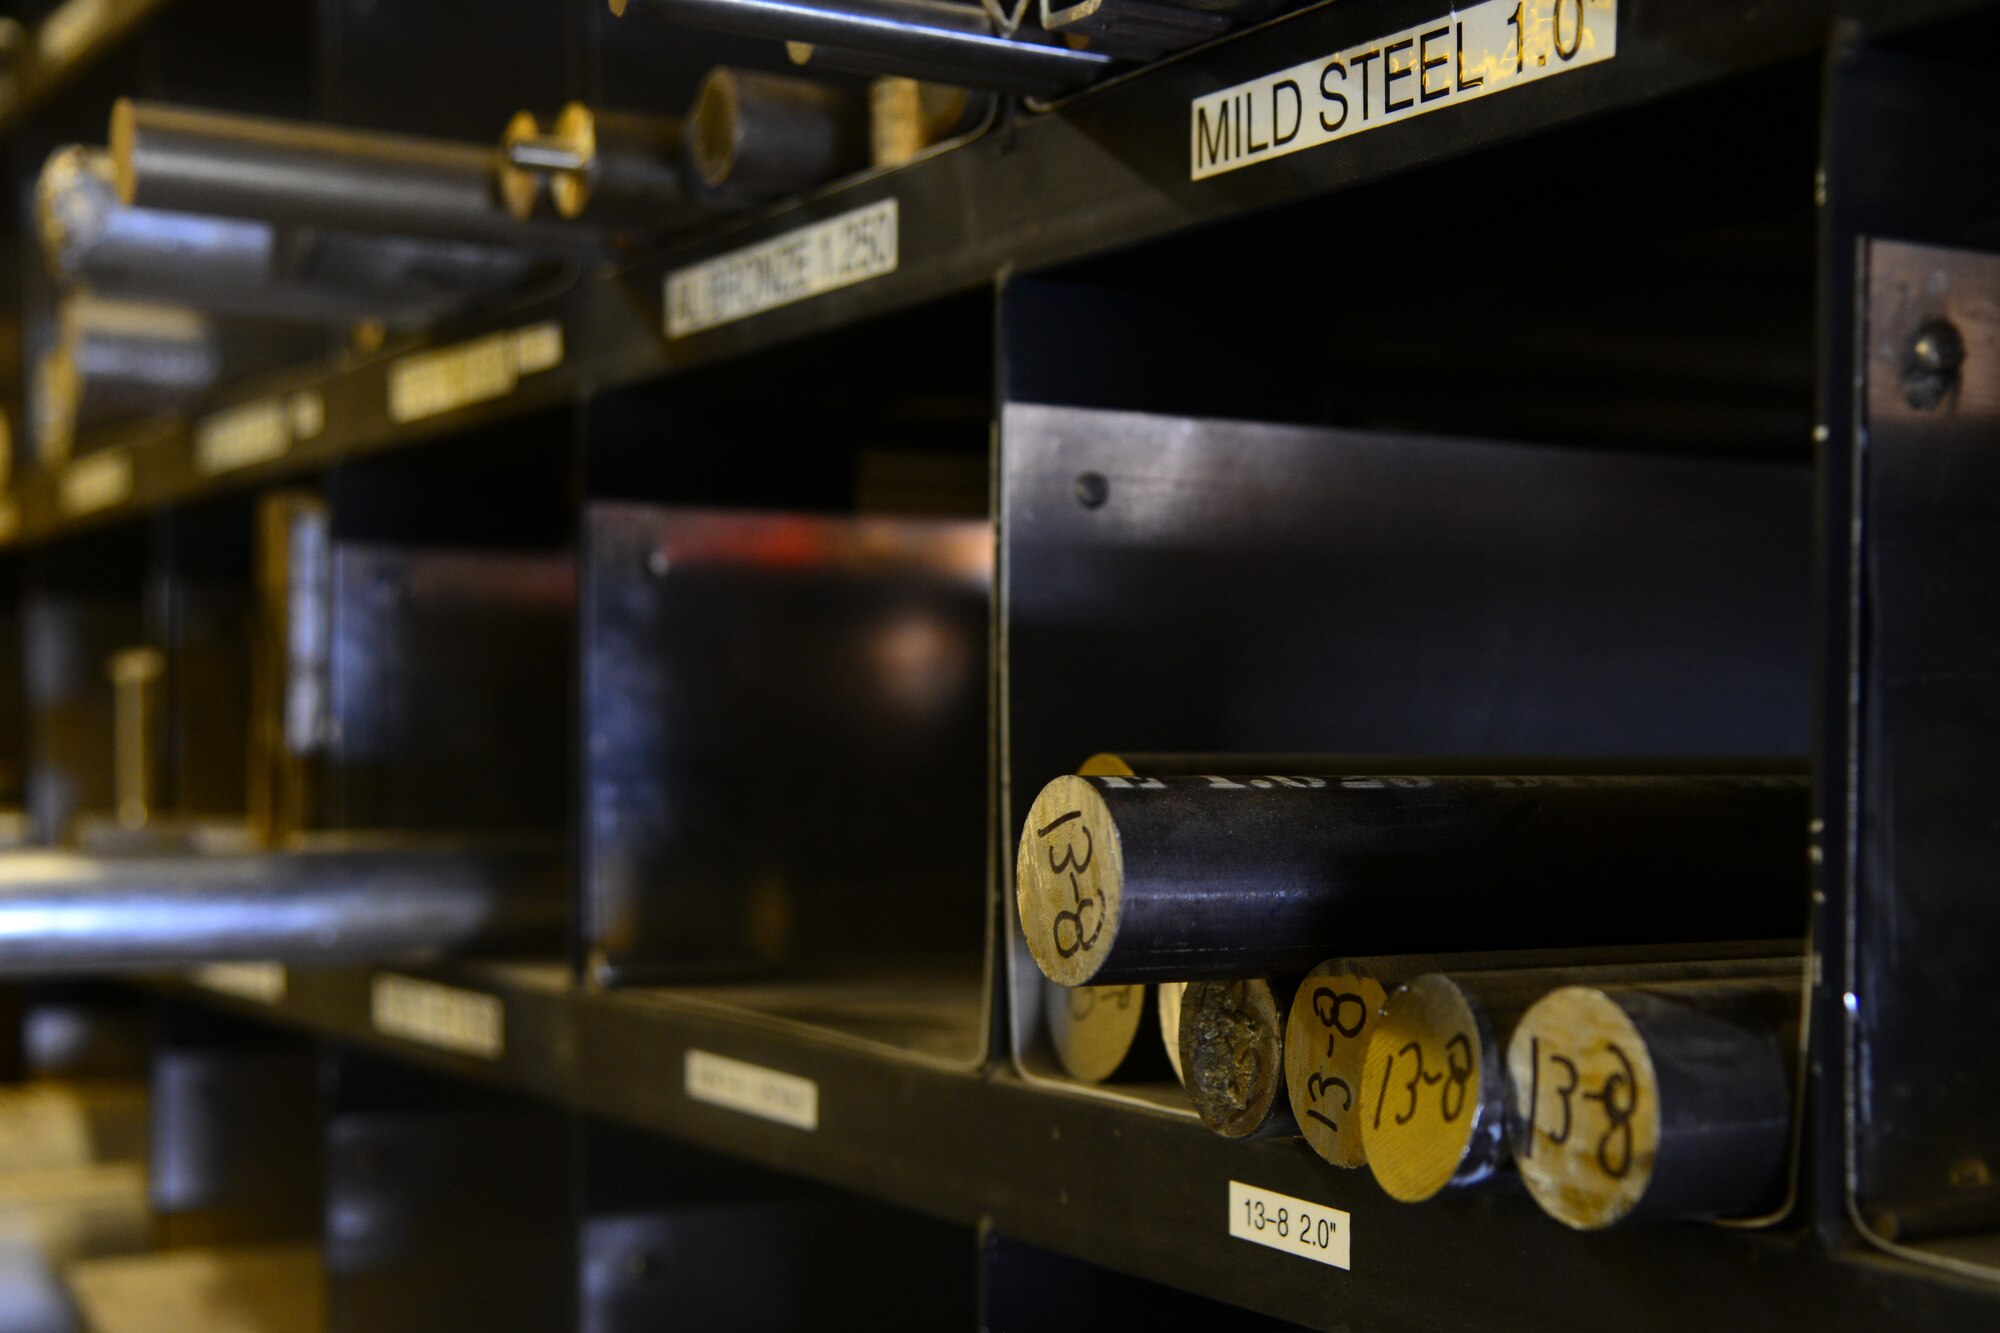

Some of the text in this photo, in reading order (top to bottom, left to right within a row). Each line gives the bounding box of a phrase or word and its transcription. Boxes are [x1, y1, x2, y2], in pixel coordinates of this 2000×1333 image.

[1197, 0, 1594, 170] MILD STEEL 1.0
[1037, 810, 1106, 959] 13-8
[1306, 986, 1367, 1133] 13-8
[1374, 1032, 1474, 1130] 13-8
[1526, 1036, 1639, 1180] 13-8
[1244, 1198, 1337, 1250] 13-8 2.0"
